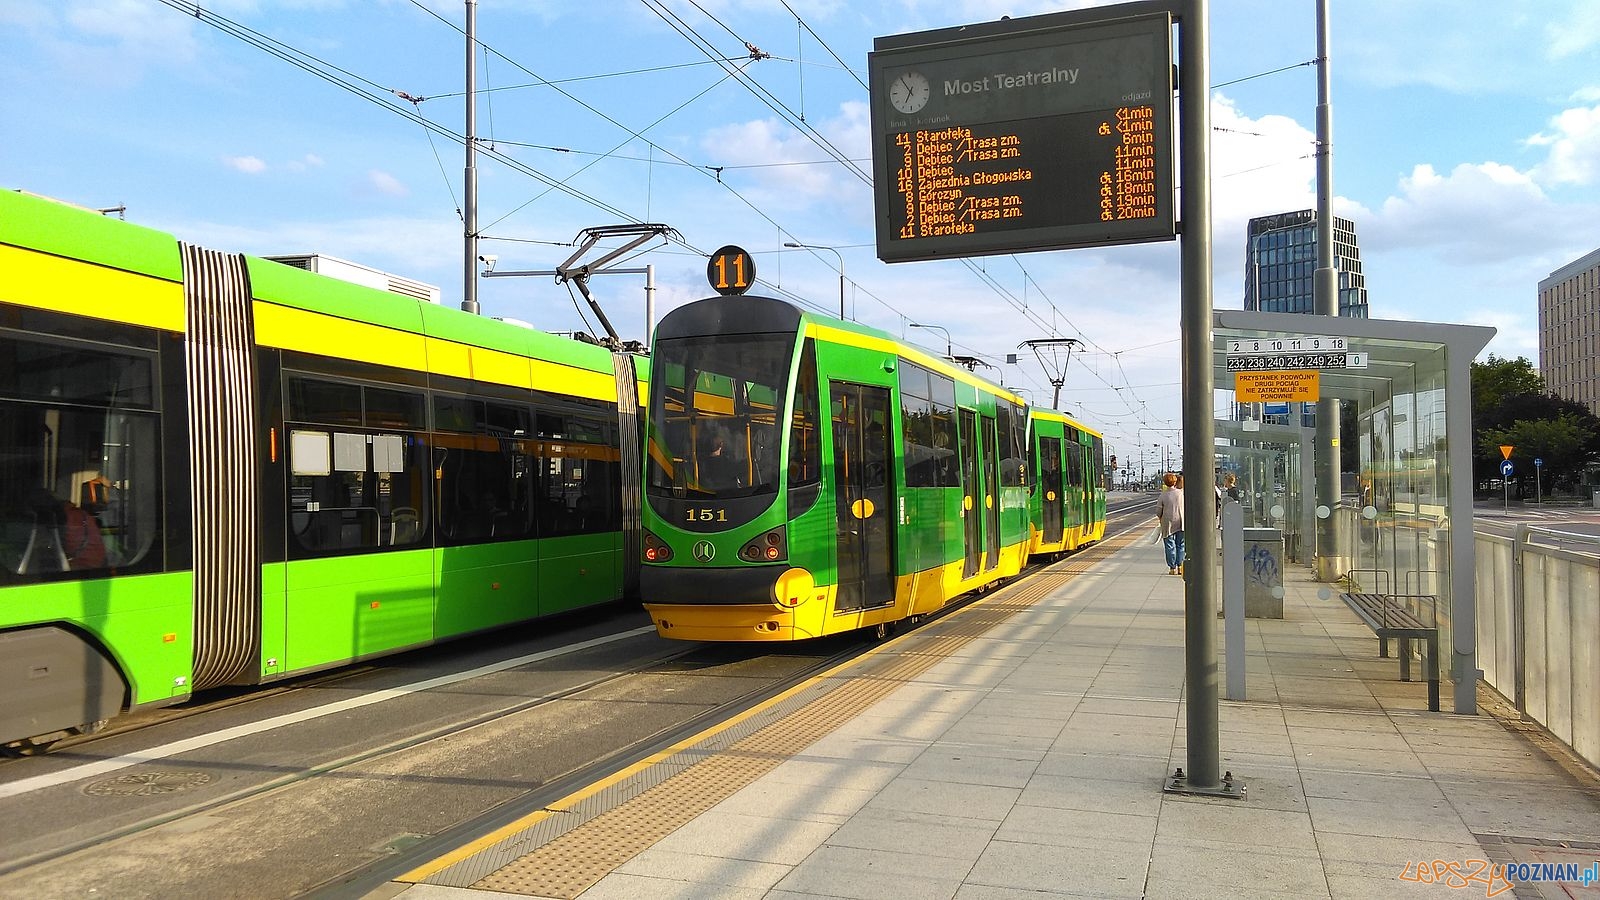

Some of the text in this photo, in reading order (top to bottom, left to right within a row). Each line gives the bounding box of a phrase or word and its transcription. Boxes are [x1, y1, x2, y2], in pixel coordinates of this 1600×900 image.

[944, 68, 1080, 96] Most Teatralny
[1122, 90, 1151, 101] odjazd
[896, 105, 1152, 146] 11 Starołęka <1min
[904, 145, 911, 156] 2
[917, 142, 953, 155] Dębiec
[1000, 135, 1020, 146] zm.
[1115, 118, 1153, 132] <1min
[898, 143, 1154, 180] 10 Dębiec 11min
[904, 157, 912, 167] 9
[917, 154, 953, 167] Dębiec
[1001, 147, 1021, 158] zm.
[1122, 130, 1153, 144] 6min
[898, 156, 1154, 192] 16 Zajezdnia Głogowska 11min
[906, 168, 1154, 202] 8 Górczyn 16min
[907, 216, 914, 226] 2
[920, 212, 956, 225] Dębiec
[1003, 207, 1023, 217] zm.
[1117, 193, 1155, 207] 19min
[920, 200, 955, 214] Dębiec
[1002, 195, 1022, 205] zm.
[1116, 181, 1154, 194] 18min
[900, 205, 1155, 238] 11 Starołęka 20min
[716, 254, 746, 288] 11
[1228, 359, 1245, 369] 232
[1248, 358, 1265, 368] 238
[1268, 358, 1285, 367] 240
[1287, 357, 1305, 367] 242
[1307, 356, 1324, 366] 249
[1327, 355, 1345, 365] 252
[1354, 356, 1360, 365] 0
[1234, 340, 1343, 351] 2 8 10 11 9 18
[686, 508, 728, 522] 151
